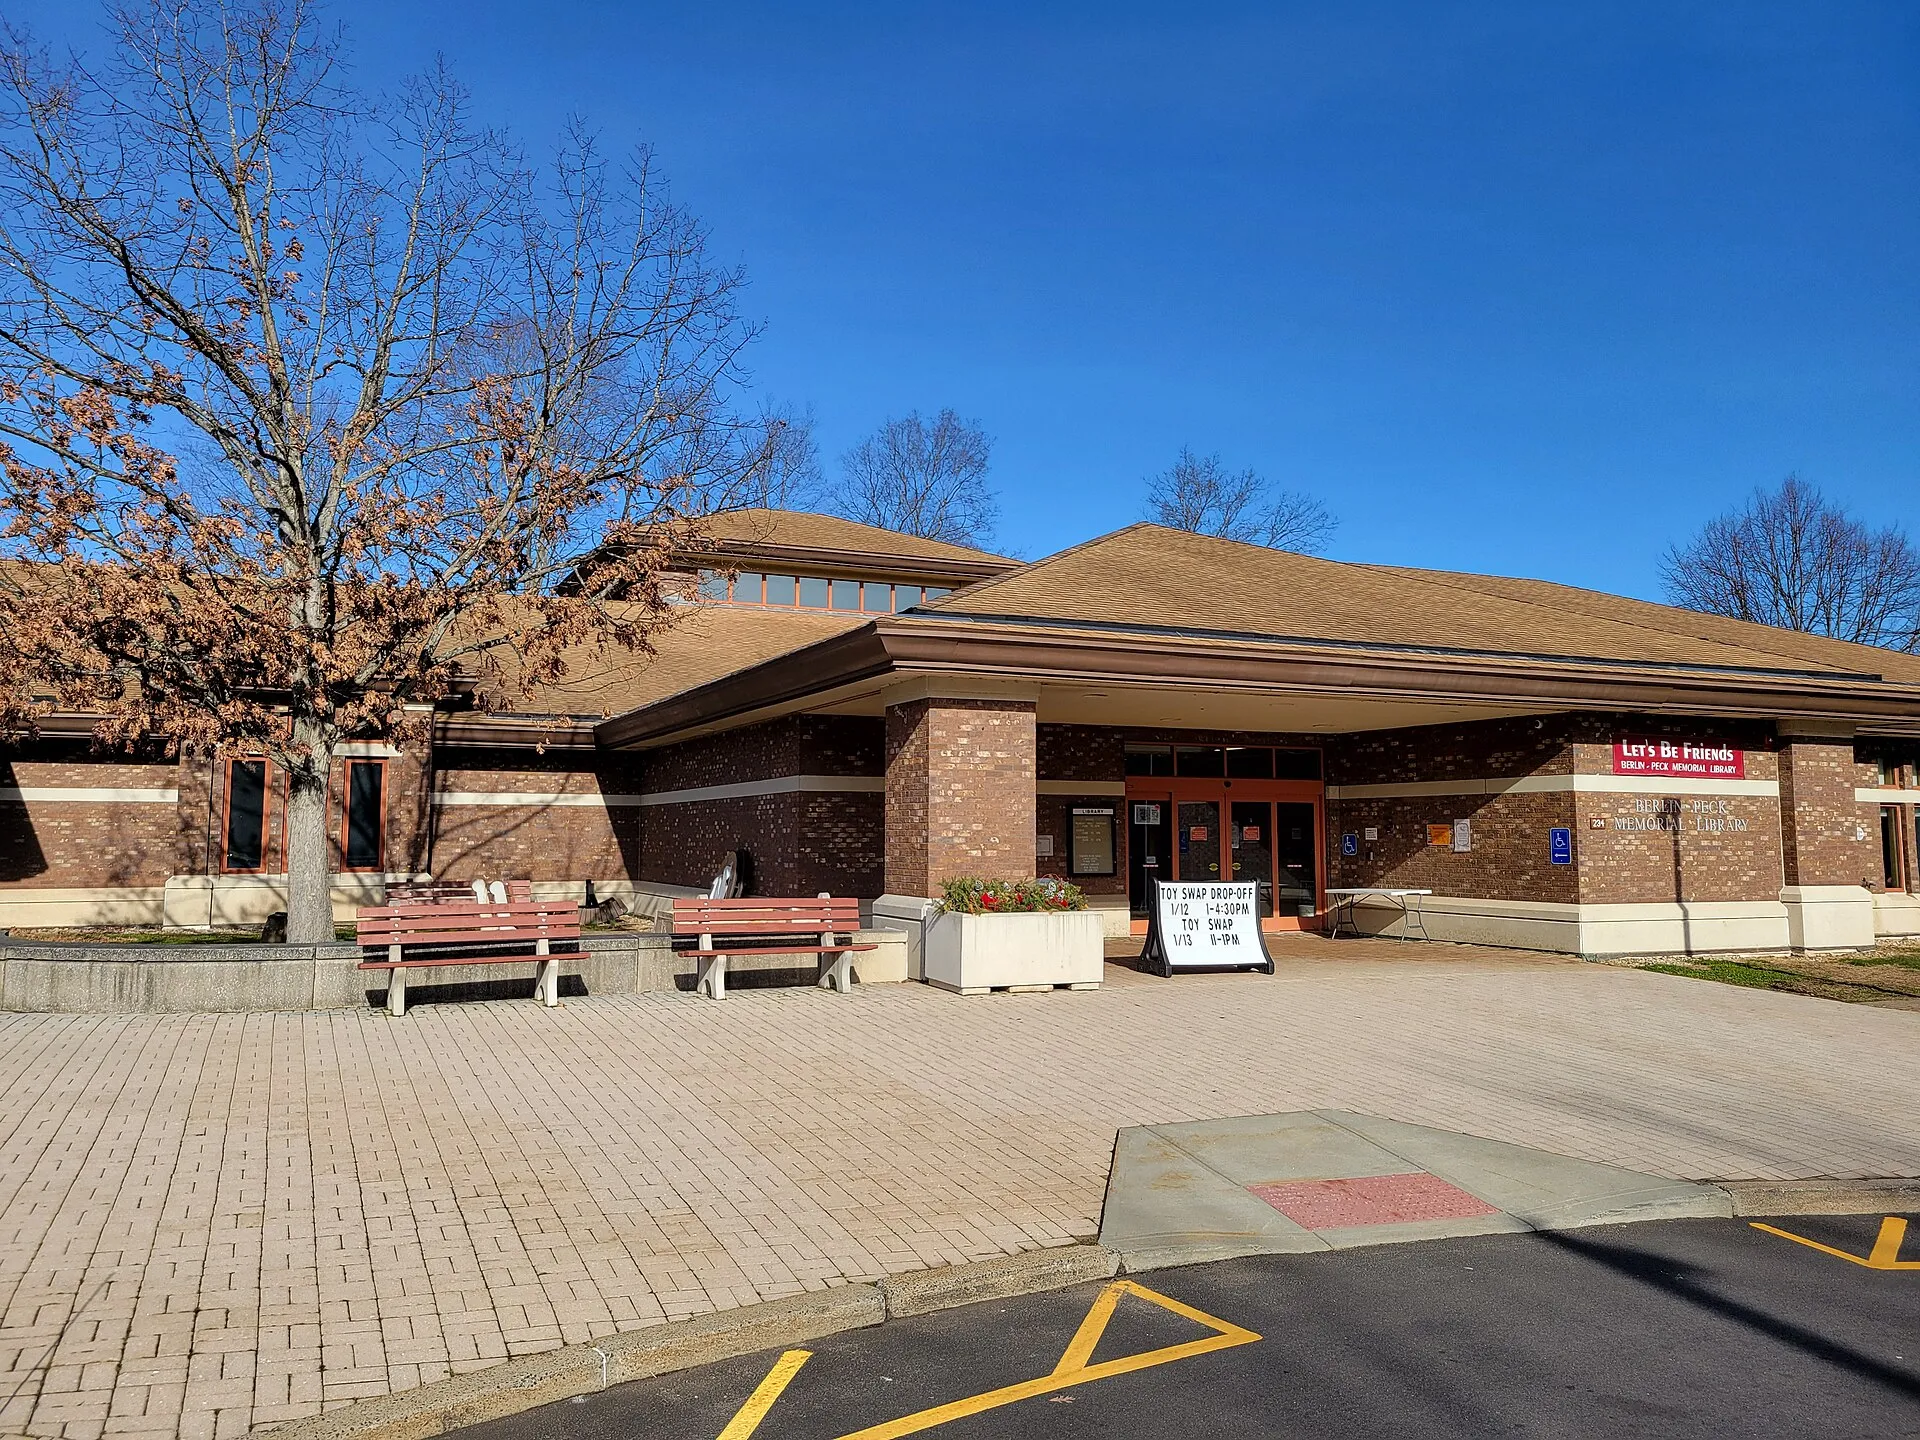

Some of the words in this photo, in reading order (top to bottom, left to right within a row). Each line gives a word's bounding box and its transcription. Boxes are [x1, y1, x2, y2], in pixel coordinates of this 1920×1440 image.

[1621, 760, 1645, 770] BERLIN
[1651, 762, 1669, 771] PECK
[1672, 762, 1707, 773] MEMORIAL
[1710, 764, 1737, 774] LIBRARY
[1635, 799, 1683, 813] BERLIN
[1693, 800, 1727, 814] PECK
[1614, 816, 1686, 831] MEMORIAL
[1697, 817, 1749, 832] LIBRARY
[1161, 887, 1178, 900] TOY
[1182, 887, 1207, 900] SWAP
[1211, 887, 1253, 900] DROP-OFF
[1171, 903, 1189, 915] 1/12
[1206, 902, 1250, 915] 1-4:30PM
[1182, 918, 1199, 931] TOY
[1208, 918, 1234, 930] SWAP
[1173, 934, 1193, 946] 1/13
[1210, 933, 1240, 946] 11-1PM
